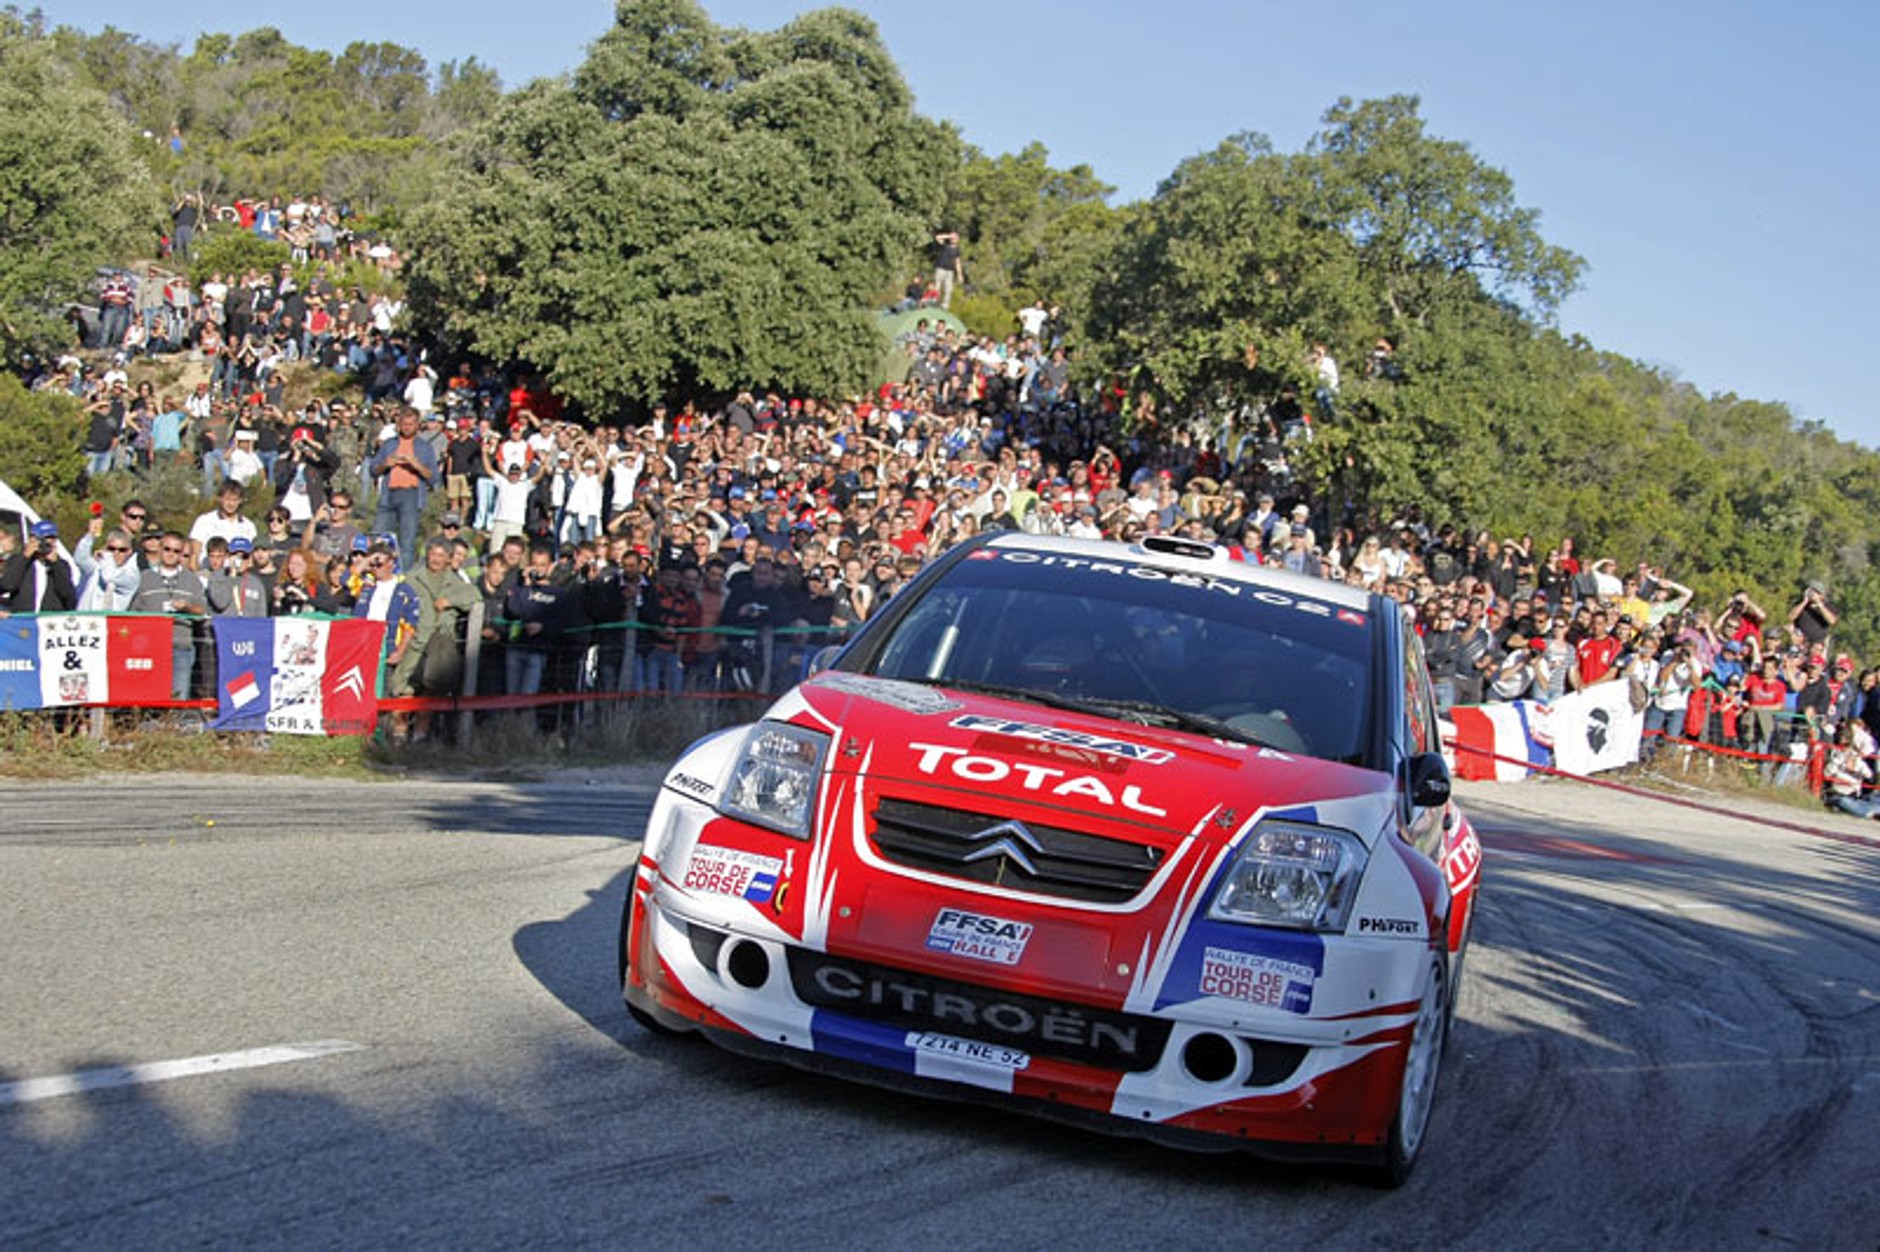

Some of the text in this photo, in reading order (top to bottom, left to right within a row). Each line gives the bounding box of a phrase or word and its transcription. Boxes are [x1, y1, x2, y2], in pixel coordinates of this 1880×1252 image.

[45, 635, 100, 650] ALLEZ
[63, 650, 83, 670] &
[909, 742, 1167, 817] TOTAL
[691, 857, 750, 880] TOUR DE
[683, 871, 745, 897] CORSE
[938, 911, 1016, 939] FFSA
[1204, 960, 1282, 990] TOUR DE
[1202, 975, 1280, 1007] CORSE
[814, 966, 1137, 1052] CITROËN
